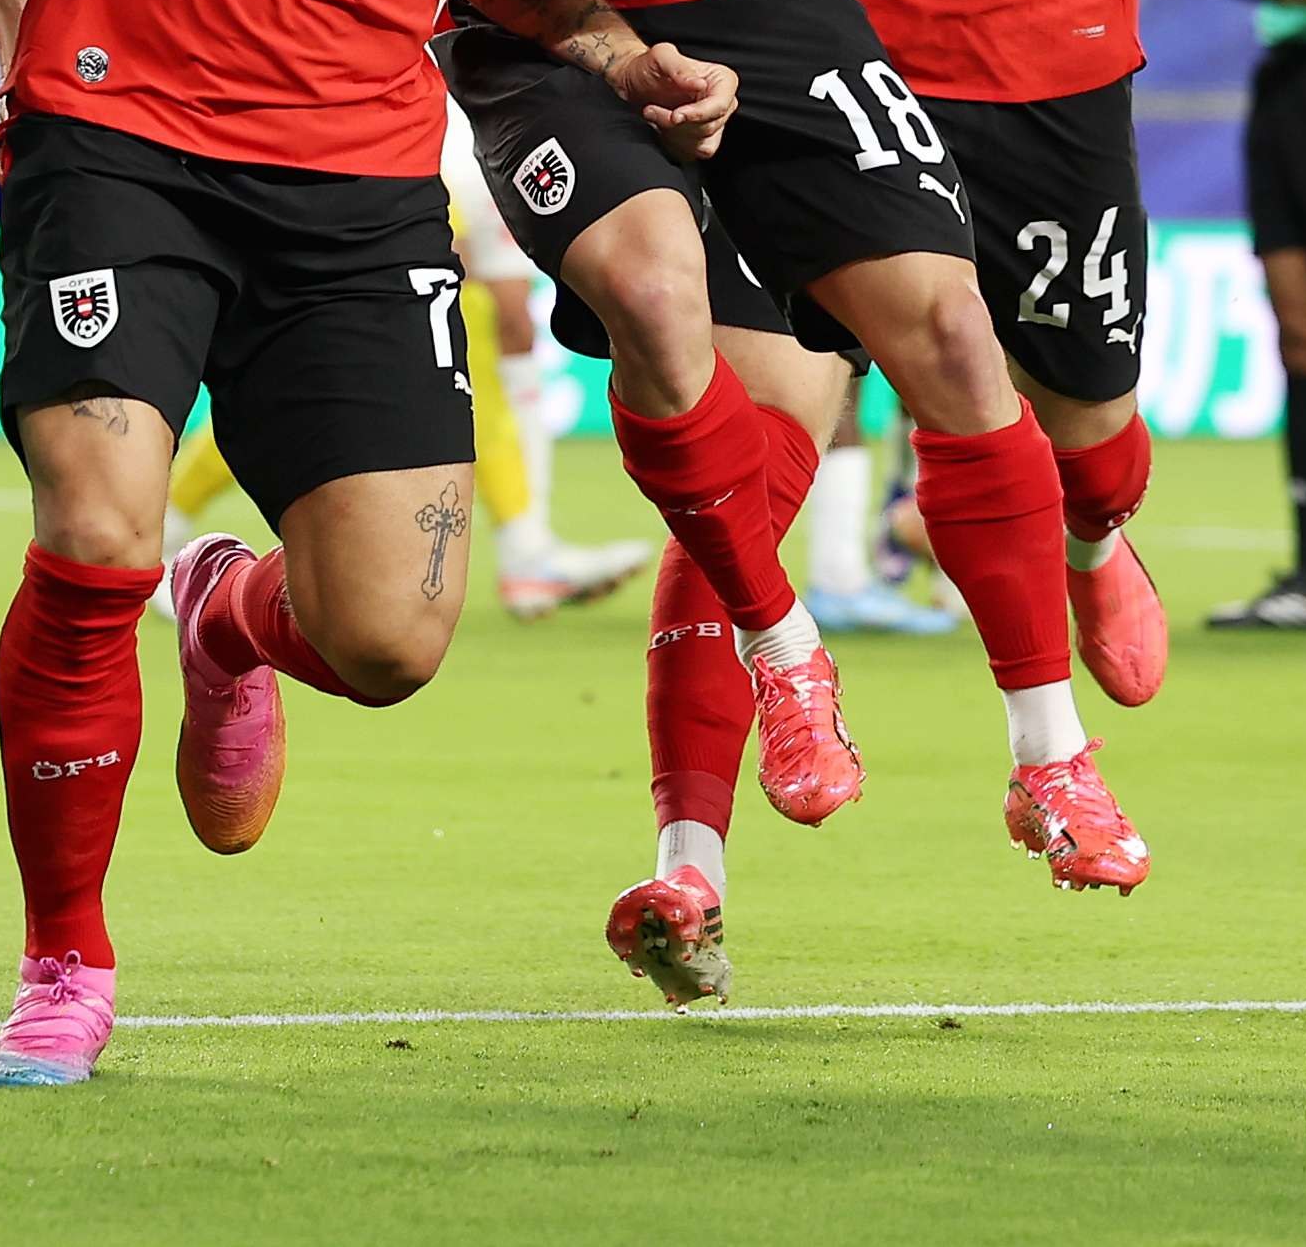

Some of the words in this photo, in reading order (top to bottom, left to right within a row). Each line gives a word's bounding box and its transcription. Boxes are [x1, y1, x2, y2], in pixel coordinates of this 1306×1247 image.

[808, 59, 946, 172] 18
[407, 268, 460, 368] 7
[1016, 206, 1131, 328] 24
[32, 750, 121, 780] ÖFB
